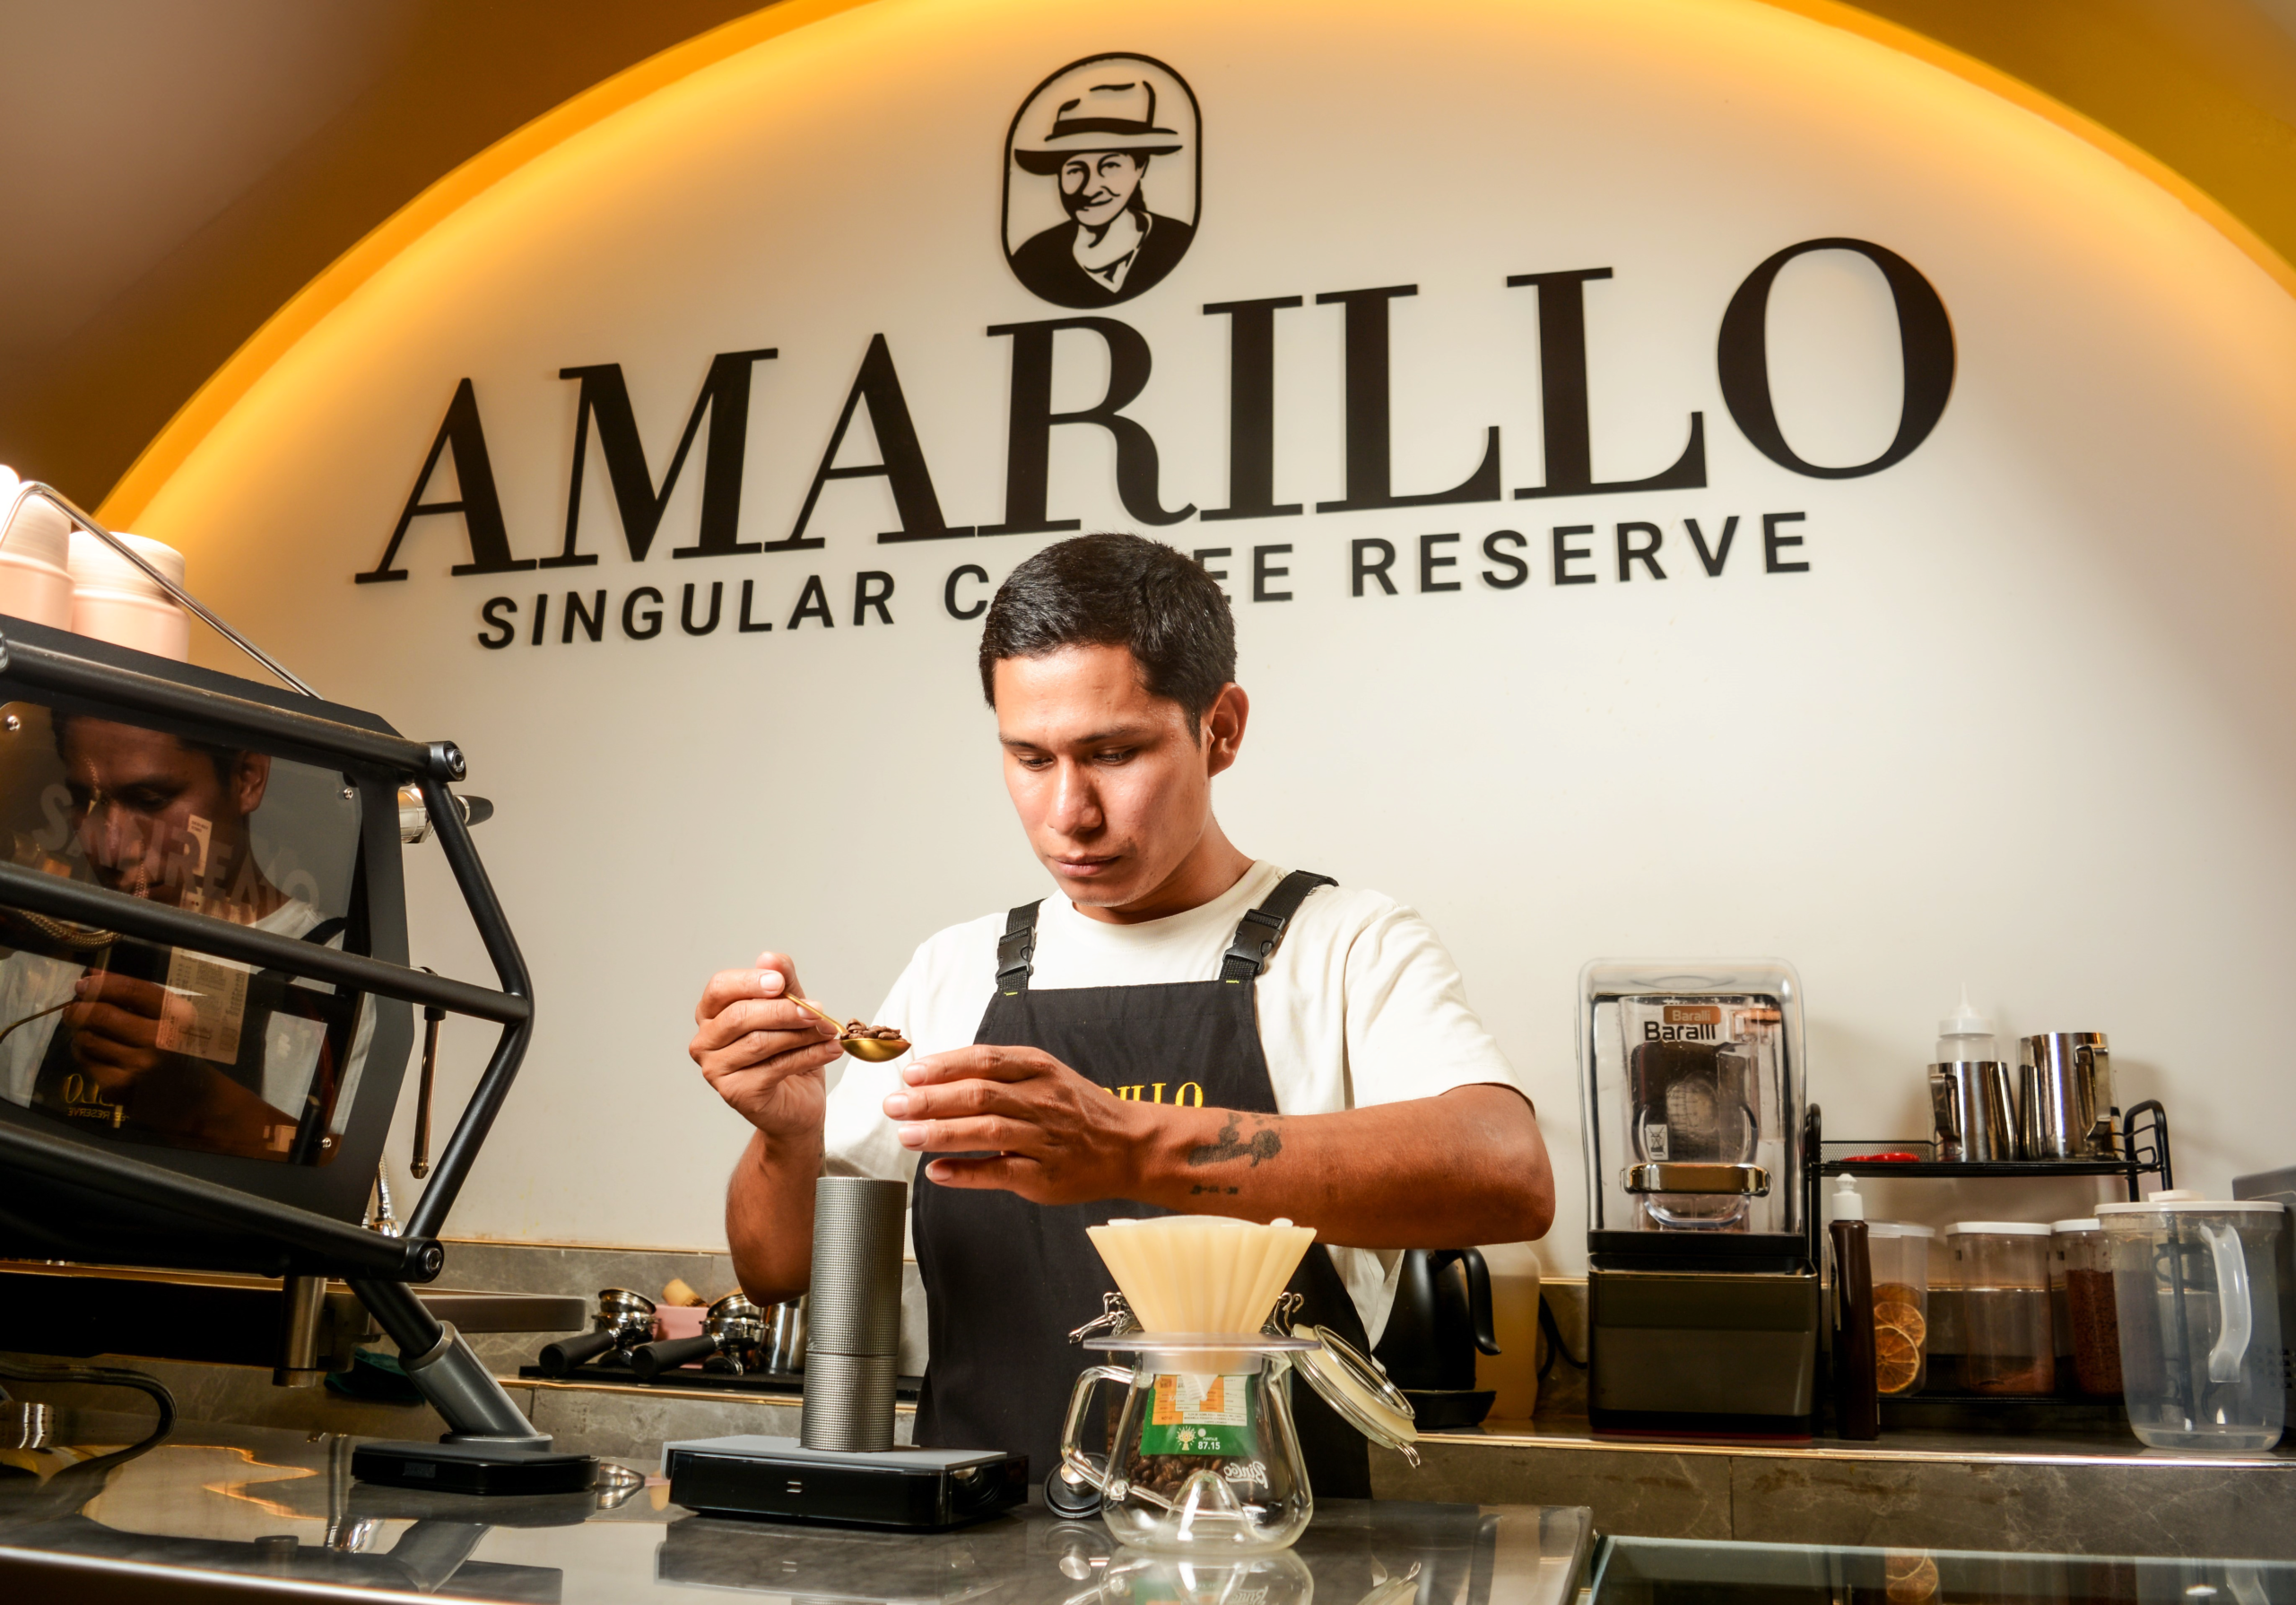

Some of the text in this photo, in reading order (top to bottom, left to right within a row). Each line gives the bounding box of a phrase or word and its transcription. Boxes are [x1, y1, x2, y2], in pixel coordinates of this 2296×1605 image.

[353, 237, 1956, 584] AMARILLO
[477, 511, 1812, 650] SINGULAR CEE RESERVE
[1672, 1009, 1711, 1022] Baralli
[1644, 1021, 1717, 1041] Baralli
[1197, 1441, 1221, 1451] 87.15
